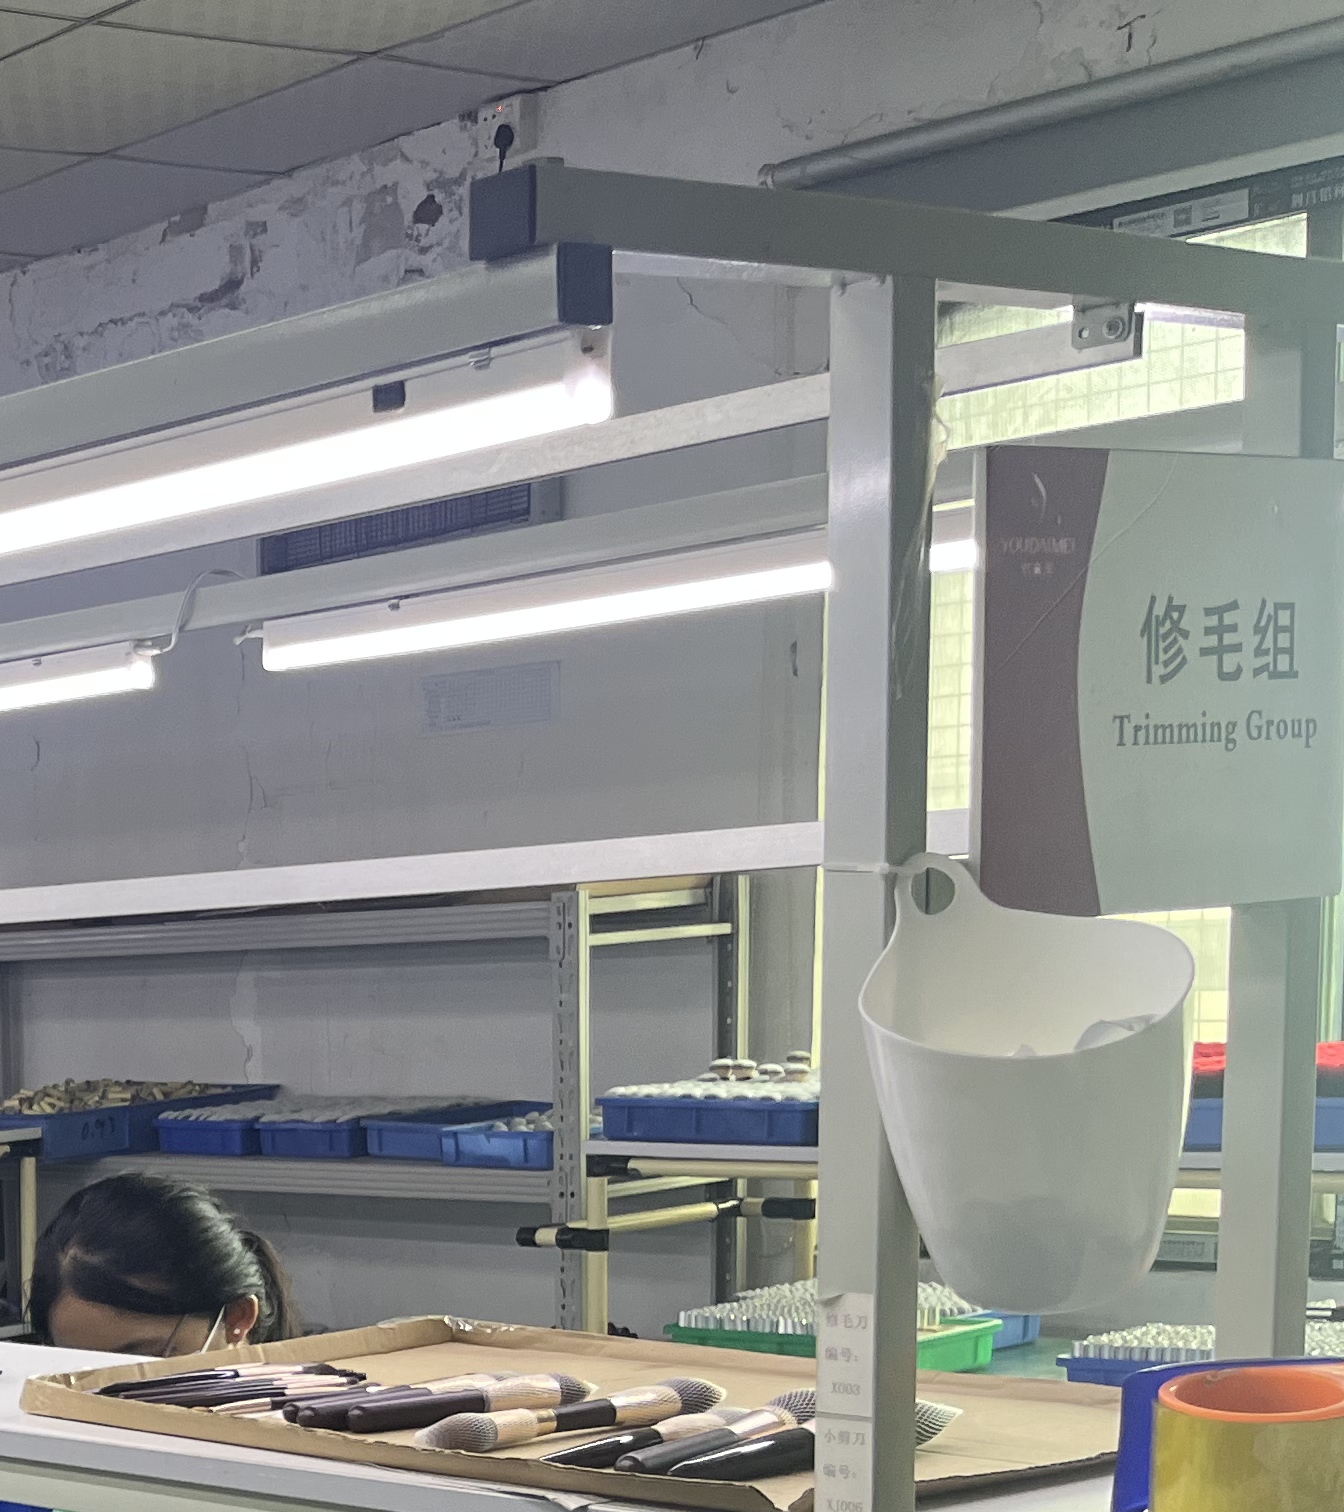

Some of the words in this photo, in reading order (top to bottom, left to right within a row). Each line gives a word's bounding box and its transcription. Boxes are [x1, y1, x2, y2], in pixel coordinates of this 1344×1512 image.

[1139, 593, 1299, 685] 修毛组
[1113, 713, 1238, 751] Trimming
[1246, 710, 1318, 749] Group
